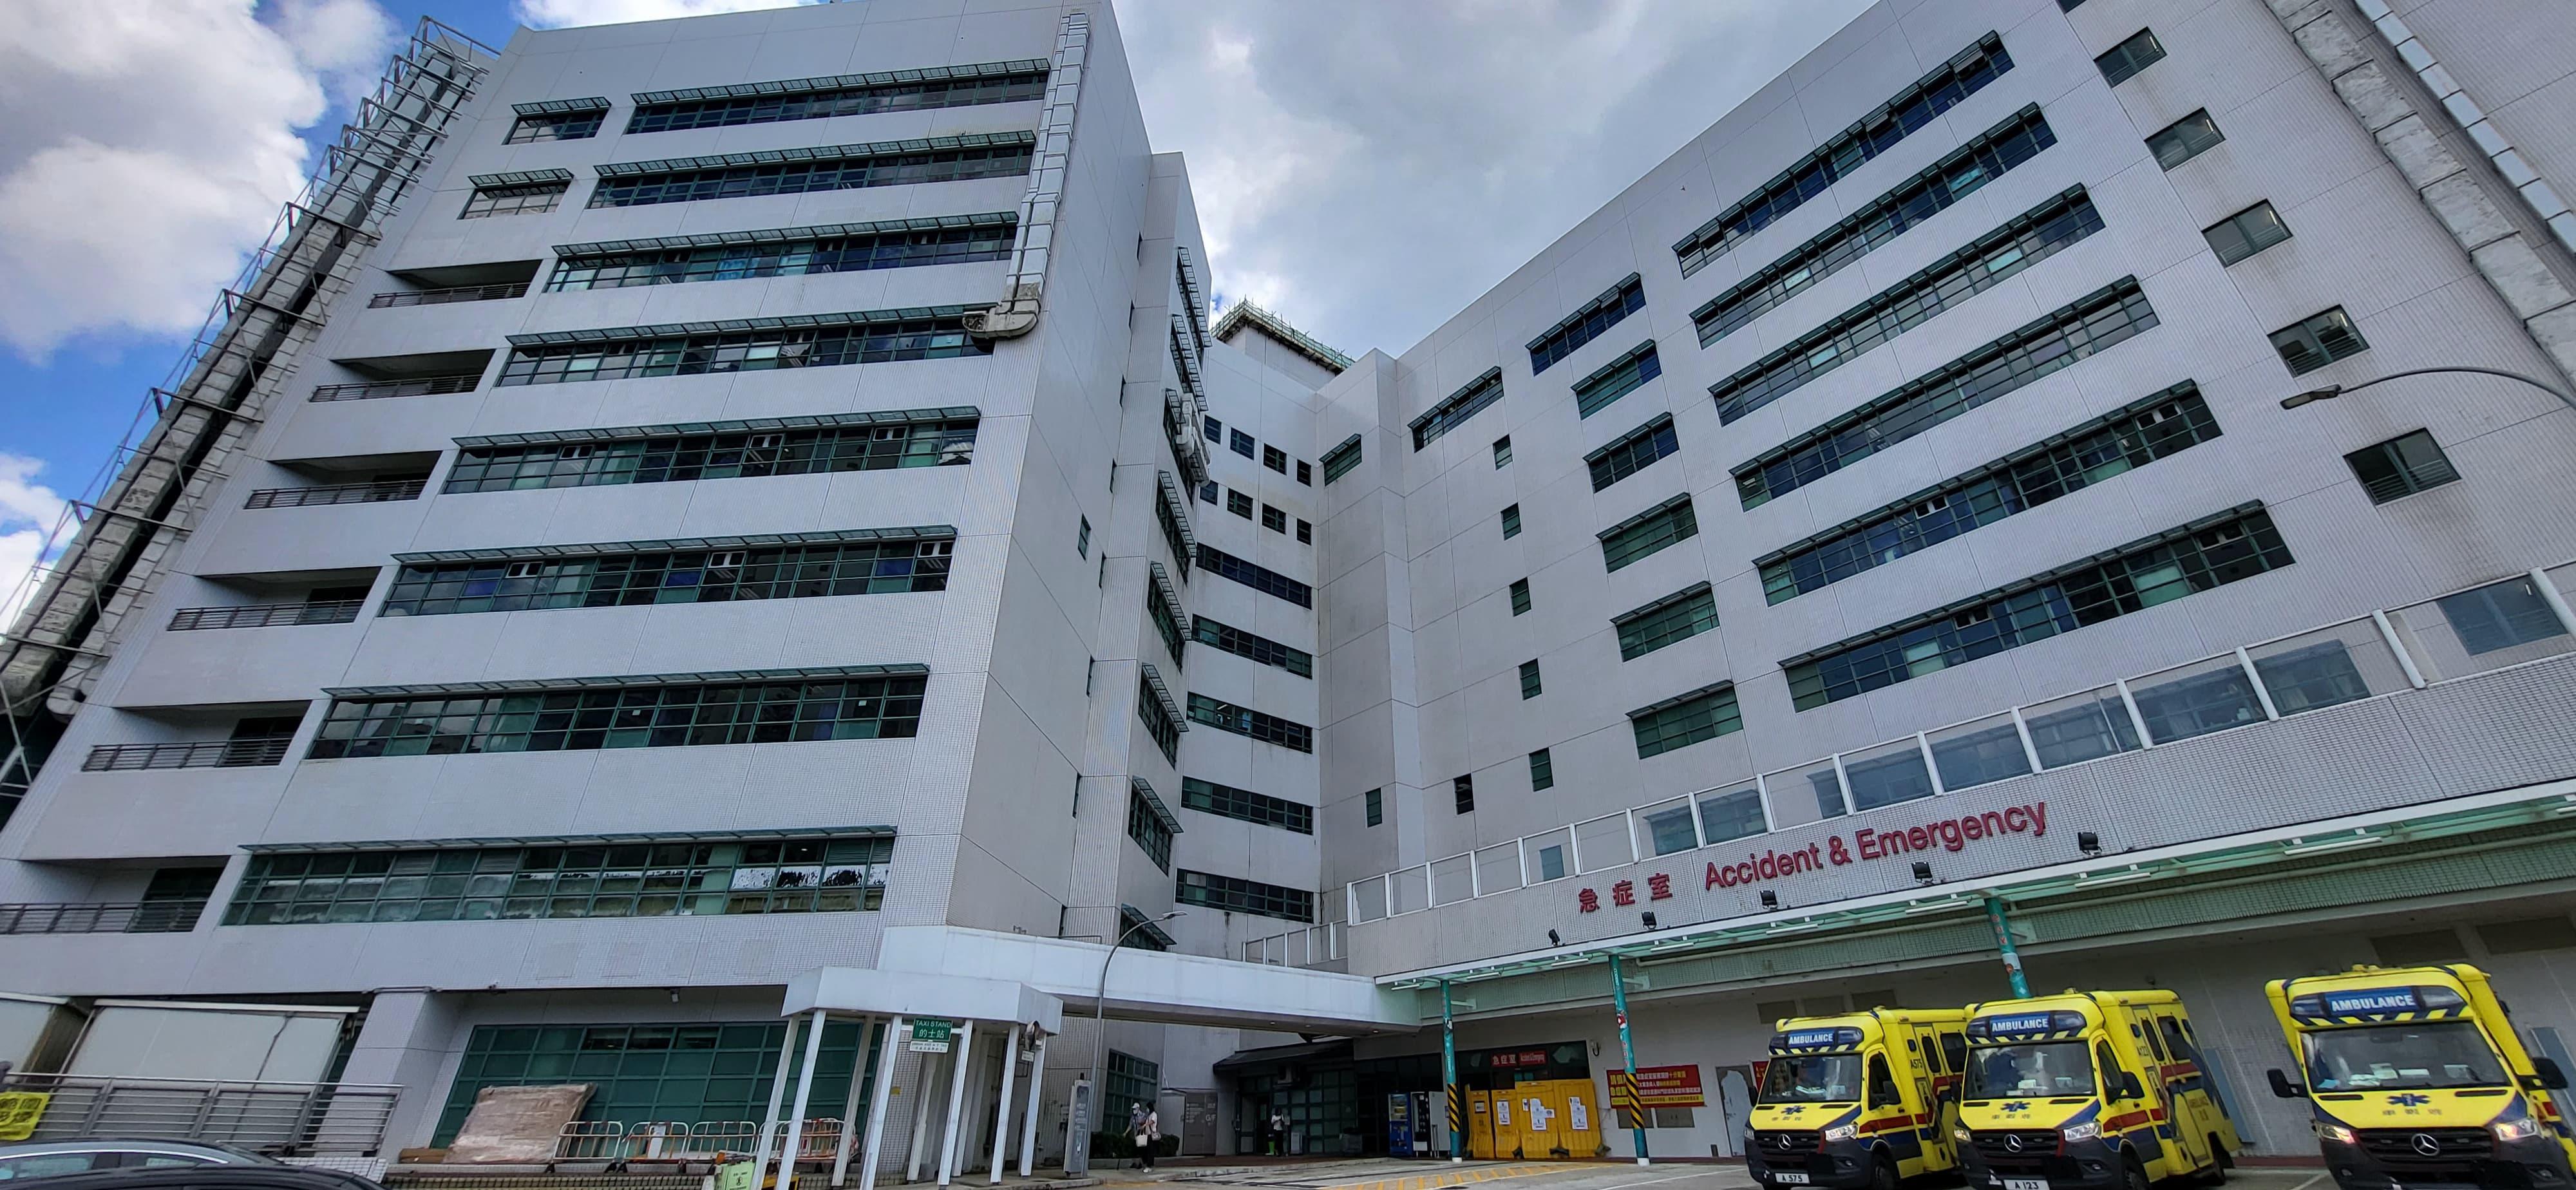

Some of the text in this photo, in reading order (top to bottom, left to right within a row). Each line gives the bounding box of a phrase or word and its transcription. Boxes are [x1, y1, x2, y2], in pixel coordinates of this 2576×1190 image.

[1705, 801, 2048, 891] Accident & Emergency
[1578, 873, 1673, 911] 急症室
[2331, 994, 2416, 1012] AMBULANCE
[918, 1028, 945, 1038] 的士站
[1992, 1018, 2049, 1032] AMBULANCE
[1788, 1033, 1833, 1044] AMBULANCE
